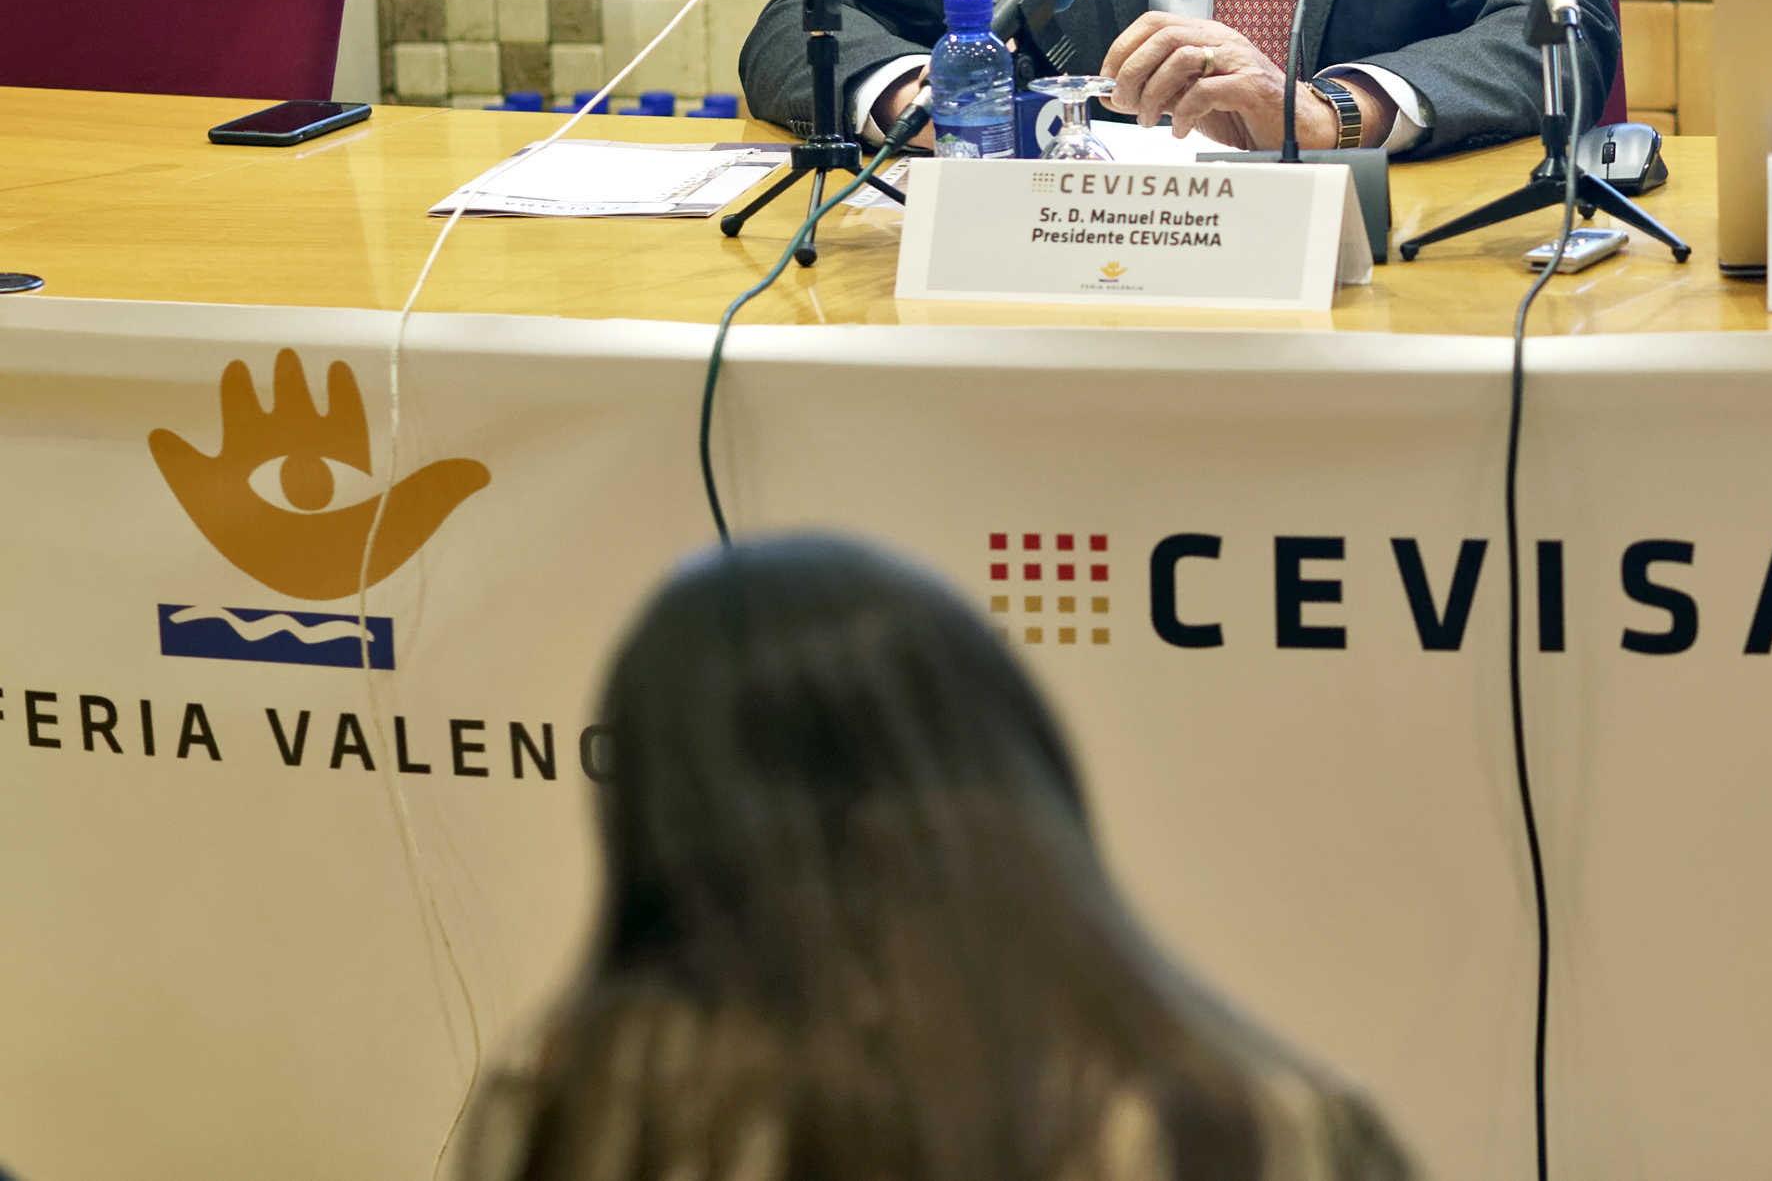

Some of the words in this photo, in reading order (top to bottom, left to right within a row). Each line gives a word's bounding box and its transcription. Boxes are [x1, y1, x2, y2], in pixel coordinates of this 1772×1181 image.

[1059, 172, 1235, 198] CEVISAMA
[1039, 207, 1062, 224] Sr.
[1068, 209, 1084, 224] D.
[1090, 209, 1155, 226] Manuel
[1160, 210, 1219, 227] Rubert
[1032, 227, 1125, 246] Presidente
[1129, 230, 1222, 247] CEVISAMA
[0, 687, 223, 763] ERIA
[264, 707, 619, 784] VALENC
